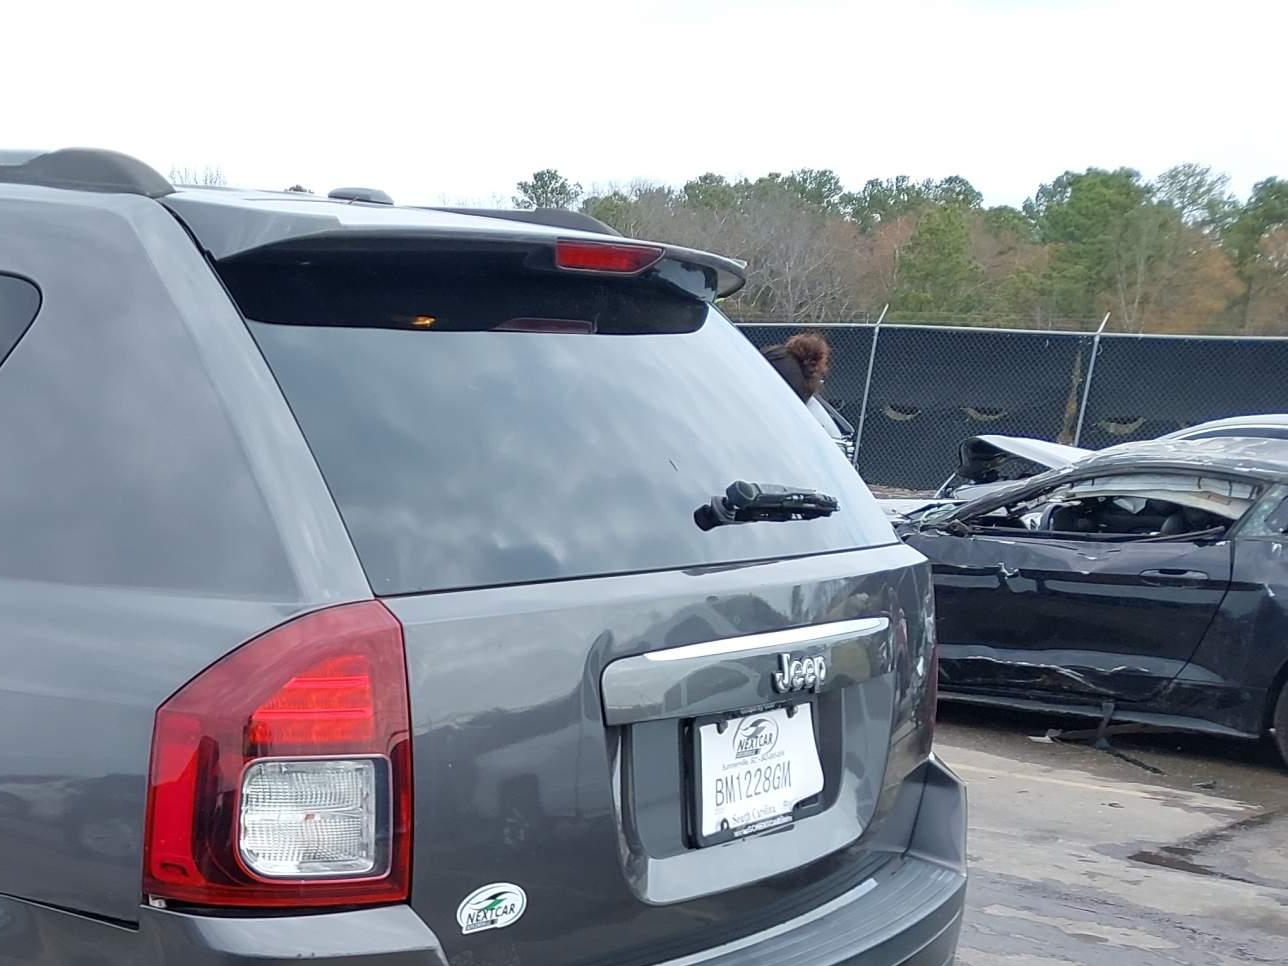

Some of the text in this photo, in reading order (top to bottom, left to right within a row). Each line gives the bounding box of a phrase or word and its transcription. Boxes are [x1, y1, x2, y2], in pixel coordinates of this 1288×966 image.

[773, 653, 827, 694] Jeep
[738, 734, 774, 751] NEXTCAR
[467, 904, 516, 922] NEXTCAR
